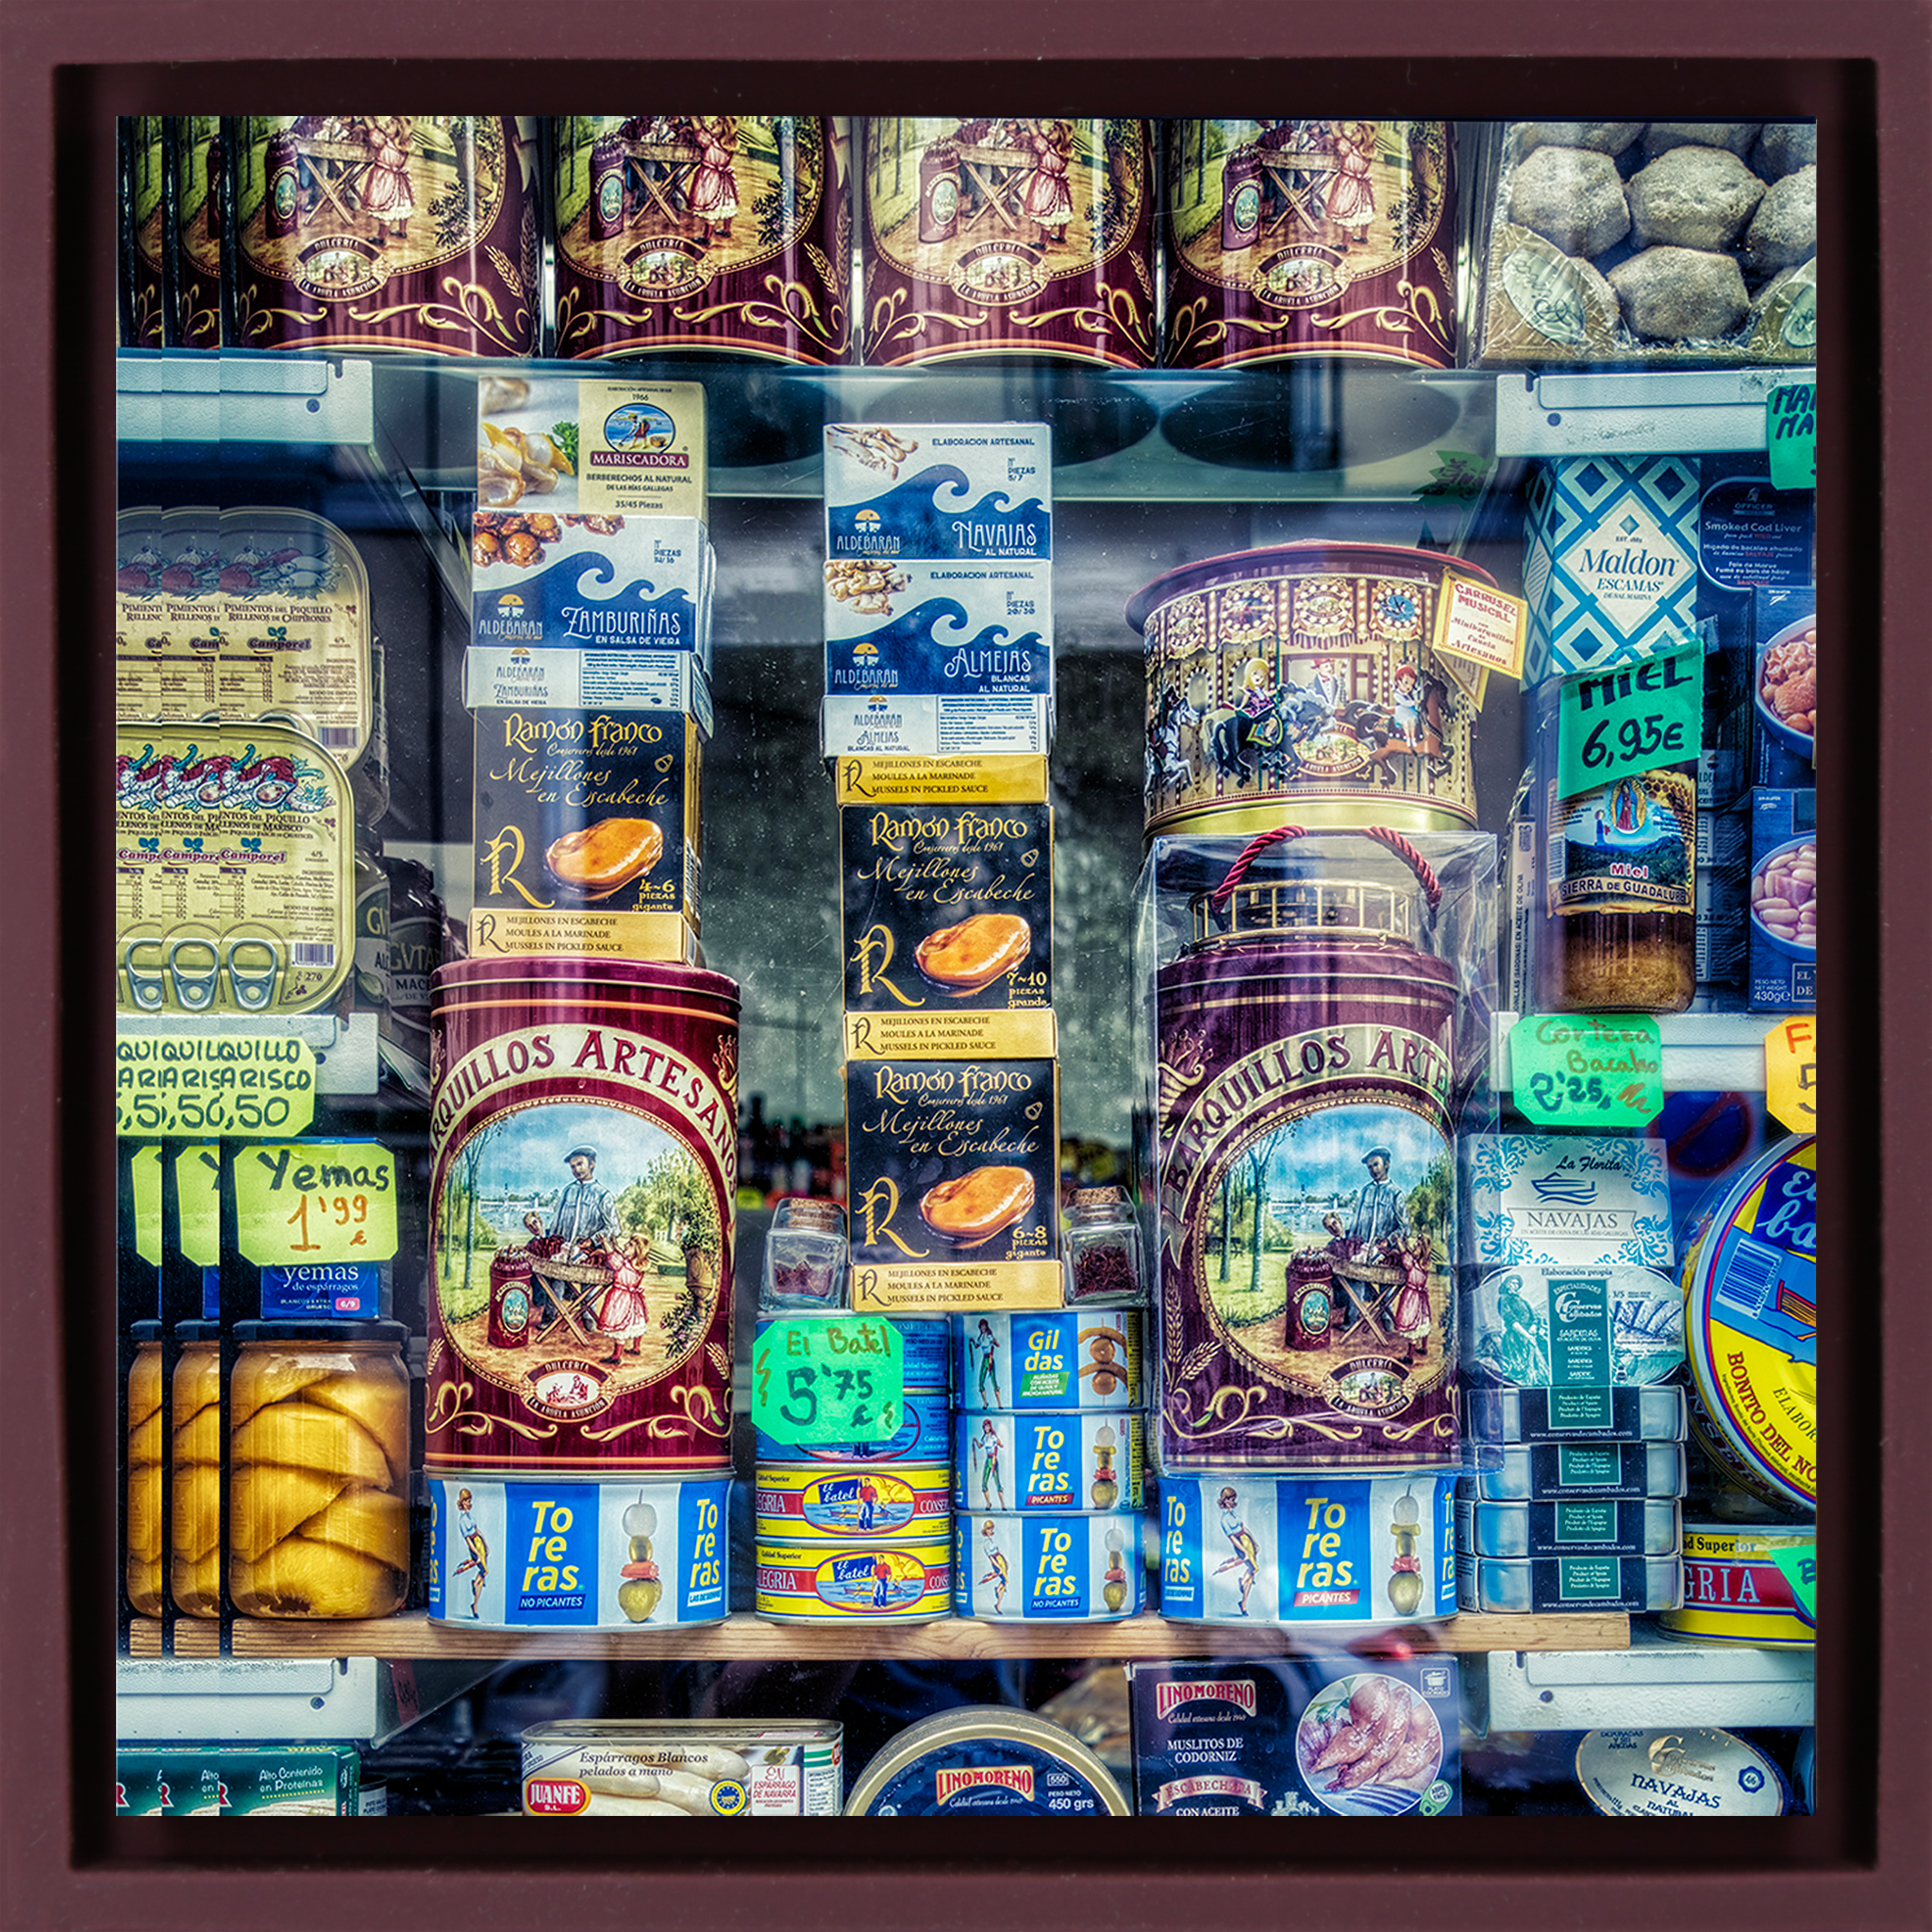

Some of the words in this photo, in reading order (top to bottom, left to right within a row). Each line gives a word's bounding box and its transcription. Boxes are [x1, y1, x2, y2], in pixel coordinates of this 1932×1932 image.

[593, 454, 686, 466] MARISCADORA
[587, 474, 642, 482] BERBERECHOS
[656, 475, 692, 484] NATURAL
[952, 521, 1037, 552] NAVAJAS
[1705, 521, 1748, 531] Smoked
[1750, 523, 1772, 532] Cod
[1774, 524, 1802, 533] Liver
[1579, 548, 1678, 577] Maldon
[1597, 578, 1660, 592] ESCAMAS
[225, 604, 274, 613] PIMIENTOS
[290, 606, 333, 616] PIQUILLO
[1455, 583, 1517, 617] CARRUSEL
[1458, 594, 1511, 624] MUSICAL
[228, 612, 270, 622] RELLENOS
[561, 607, 680, 640] ZAMBURIÑAS
[595, 635, 608, 643] EN
[609, 636, 635, 644] SALSA
[637, 636, 651, 644] DE
[653, 637, 680, 645] VIEIRA
[944, 648, 1031, 677] ALMEJAS
[1451, 640, 1507, 665] Artesanos
[504, 712, 584, 754] Ramón
[490, 757, 612, 793] Mejillones
[538, 791, 560, 803] en
[566, 777, 669, 808] Escabeche
[263, 823, 303, 832] MARISCO
[869, 811, 950, 852] Ramón
[221, 849, 285, 862] Camporel
[858, 855, 978, 891] Mejillones
[1609, 862, 1649, 879] Miel
[906, 890, 928, 901] en
[933, 873, 1035, 905] Escabeche
[1561, 879, 1603, 897] SIERRA
[1607, 881, 1621, 891] DE
[1623, 880, 1687, 902] GUADALUPE
[874, 1065, 955, 1105] Ramón
[1166, 1035, 1352, 1196] BARQUILLOS
[257, 1149, 389, 1191] Yemas
[1556, 1155, 1575, 1170] La
[1579, 1156, 1622, 1173] Florita
[1527, 1211, 1618, 1230] NAVAJAS
[283, 1266, 358, 1288] yemas
[1541, 1268, 1586, 1276] Elaboración
[292, 1282, 305, 1291] de
[1028, 1329, 1059, 1350] Gil
[1024, 1352, 1064, 1372] das
[1726, 1351, 1766, 1425] BONITO
[1759, 1423, 1793, 1462] DEL
[1034, 1426, 1065, 1450] To
[1032, 1451, 1060, 1471] re
[824, 1491, 855, 1503] batel
[1031, 1495, 1068, 1505] PICANTES
[532, 1500, 574, 1534] To
[1304, 1497, 1347, 1530] To
[528, 1536, 567, 1562] re
[1040, 1528, 1072, 1552] To
[1302, 1532, 1341, 1559] re
[1039, 1554, 1067, 1574] re
[520, 1597, 536, 1607] NO
[537, 1596, 583, 1607] PICANTES
[1032, 1600, 1044, 1608] NO
[1045, 1599, 1079, 1608] PICANTES
[1302, 1591, 1352, 1605] PICANTES
[1167, 1739, 1224, 1751] MUSLITOS
[1226, 1737, 1244, 1750] DE
[579, 1751, 655, 1765] Espárragos
[658, 1752, 708, 1764] Blancos
[1174, 1750, 1238, 1764] CODORNIZ
[258, 1769, 276, 1781] Alto
[277, 1766, 324, 1779] Contenido
[578, 1766, 626, 1778] pelados
[629, 1768, 637, 1776] a
[639, 1768, 674, 1776] mano
[259, 1784, 272, 1792] en
[275, 1778, 324, 1791] Proteínas
[530, 1784, 580, 1806] JUANFE
[1165, 1778, 1253, 1796] ESCABECHADA
[1630, 1773, 1723, 1809] NAVAJAS
[1048, 1799, 1072, 1810] 450
[1074, 1800, 1094, 1812] grs
[1201, 1806, 1240, 1817] ACEITE
[1667, 1799, 1679, 1808] AL
